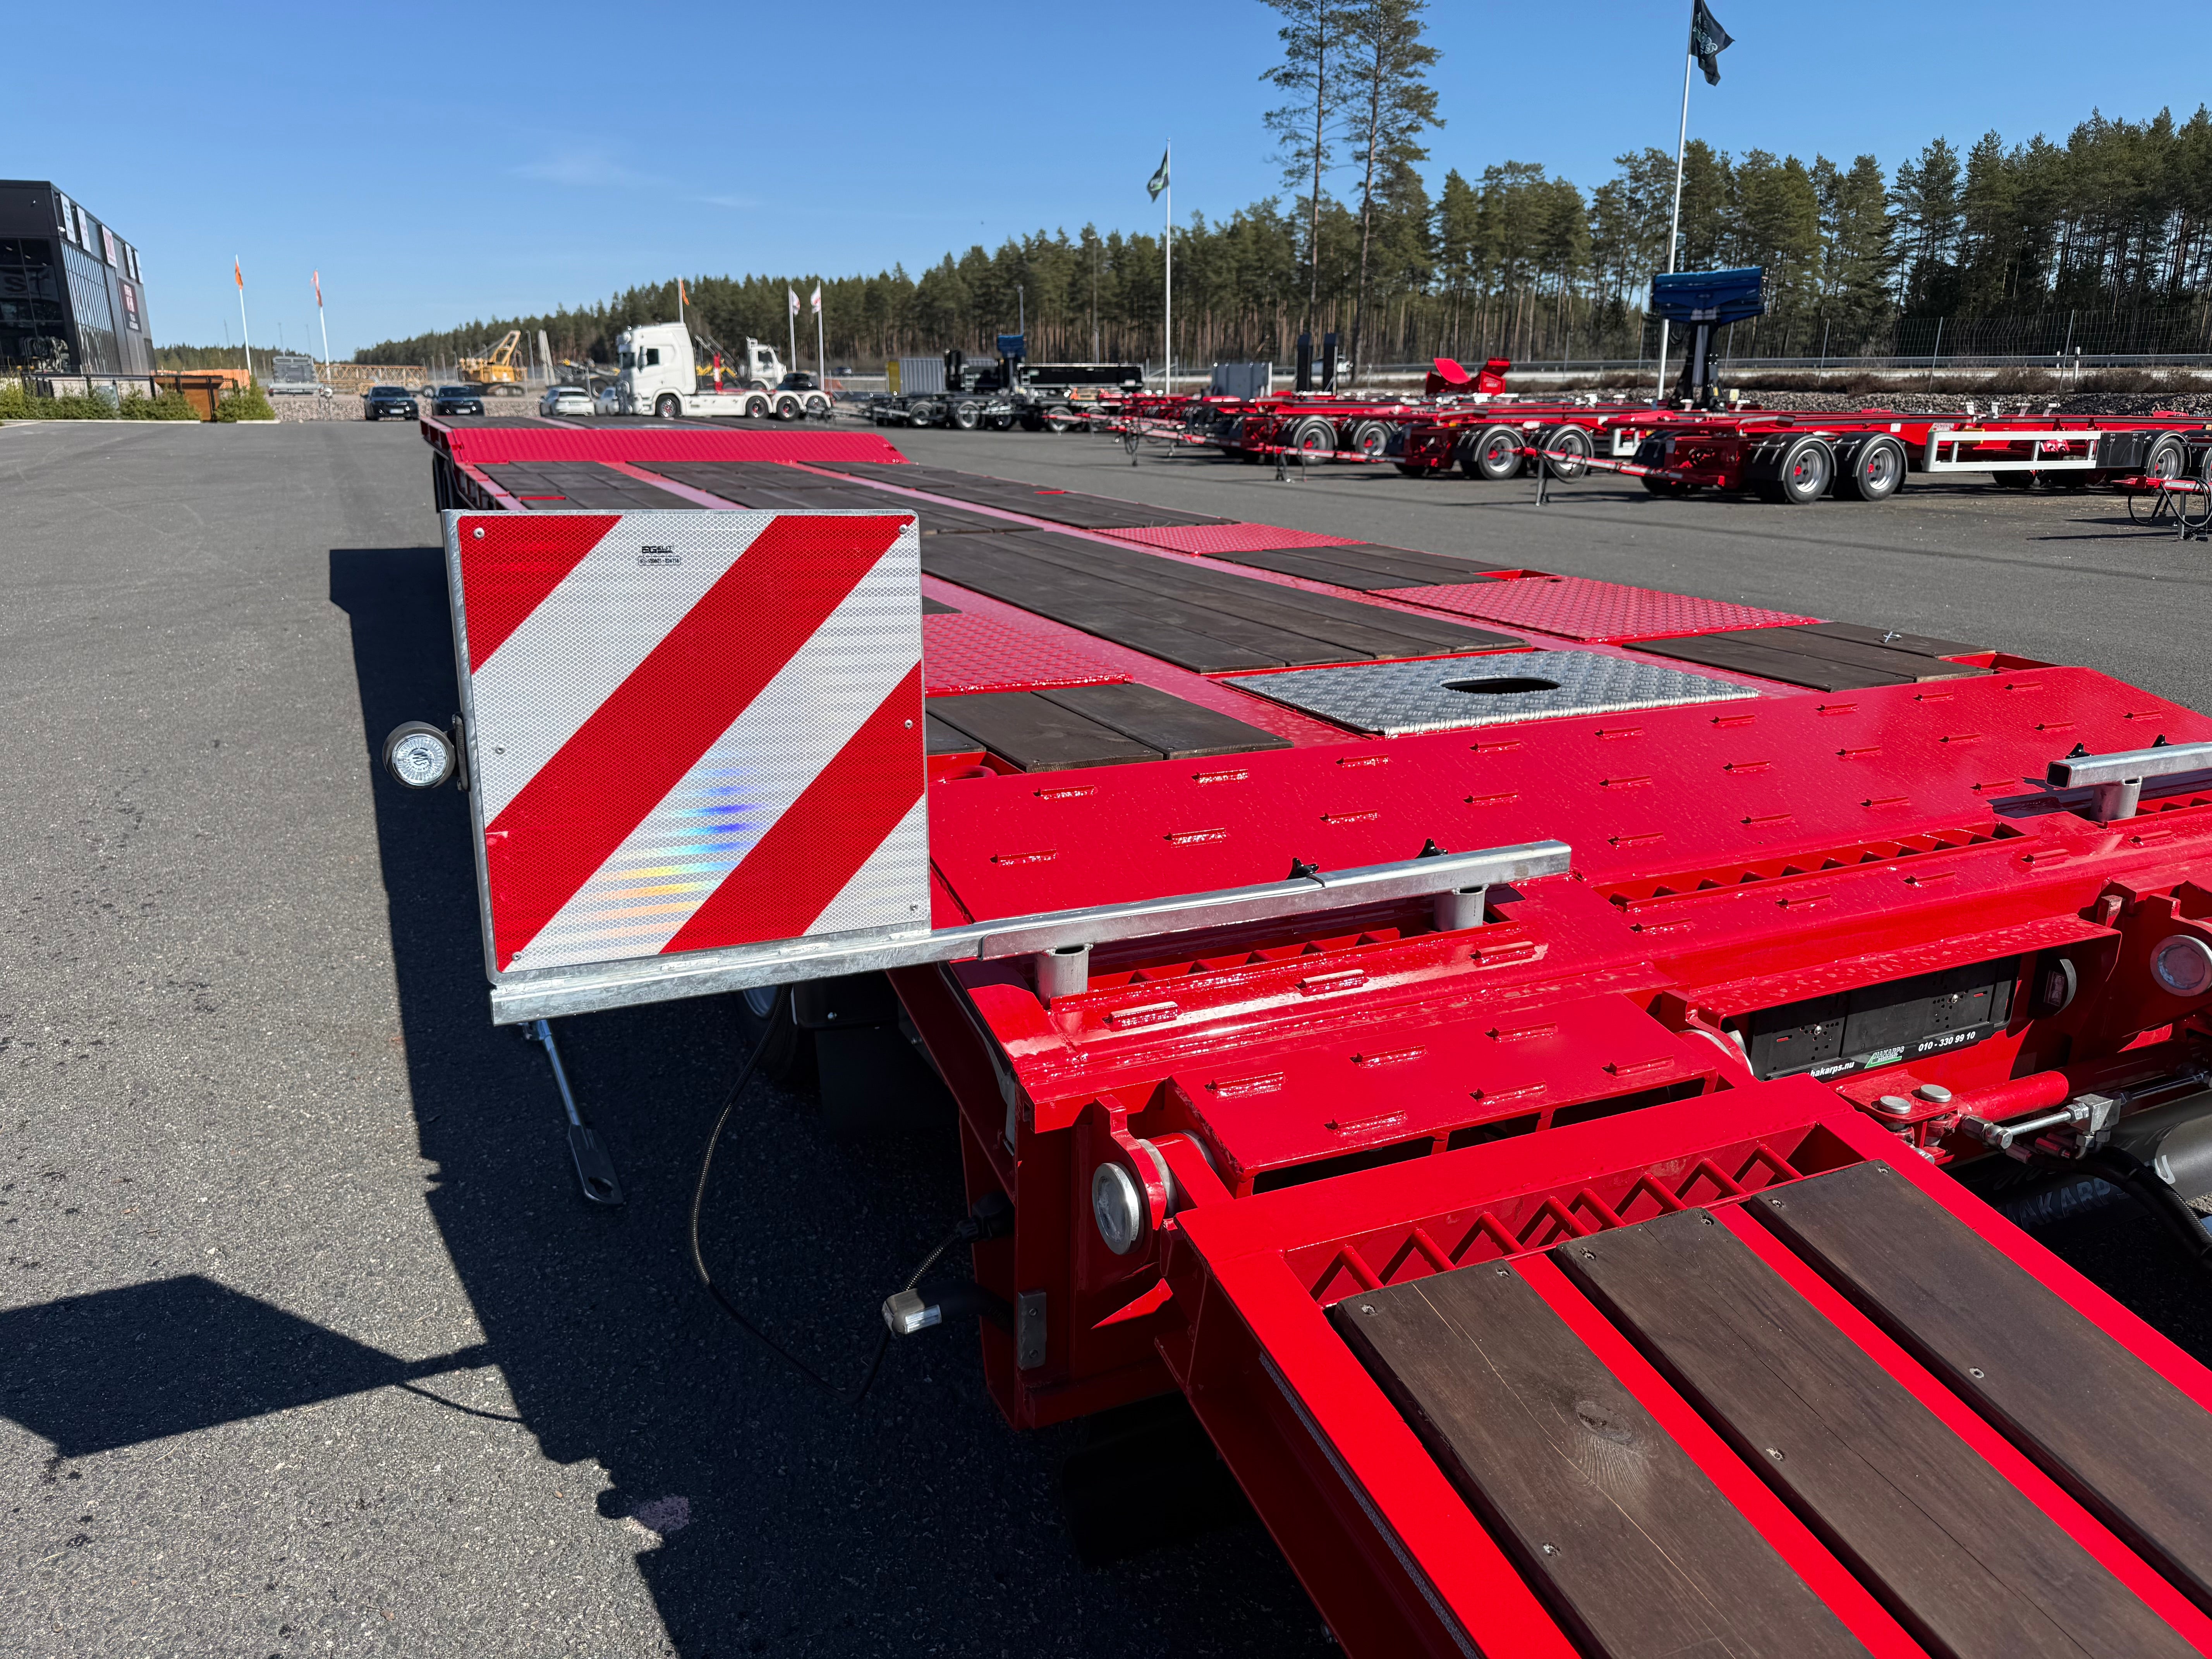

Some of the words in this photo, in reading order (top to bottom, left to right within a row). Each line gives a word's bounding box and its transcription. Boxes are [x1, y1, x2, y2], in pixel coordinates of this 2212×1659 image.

[1918, 1041, 1933, 1052] 010
[1939, 1036, 1954, 1047] 330
[1955, 1034, 1965, 1043] 99
[1966, 1031, 1976, 1040] 10
[1808, 1061, 1855, 1077] hakarps.nu
